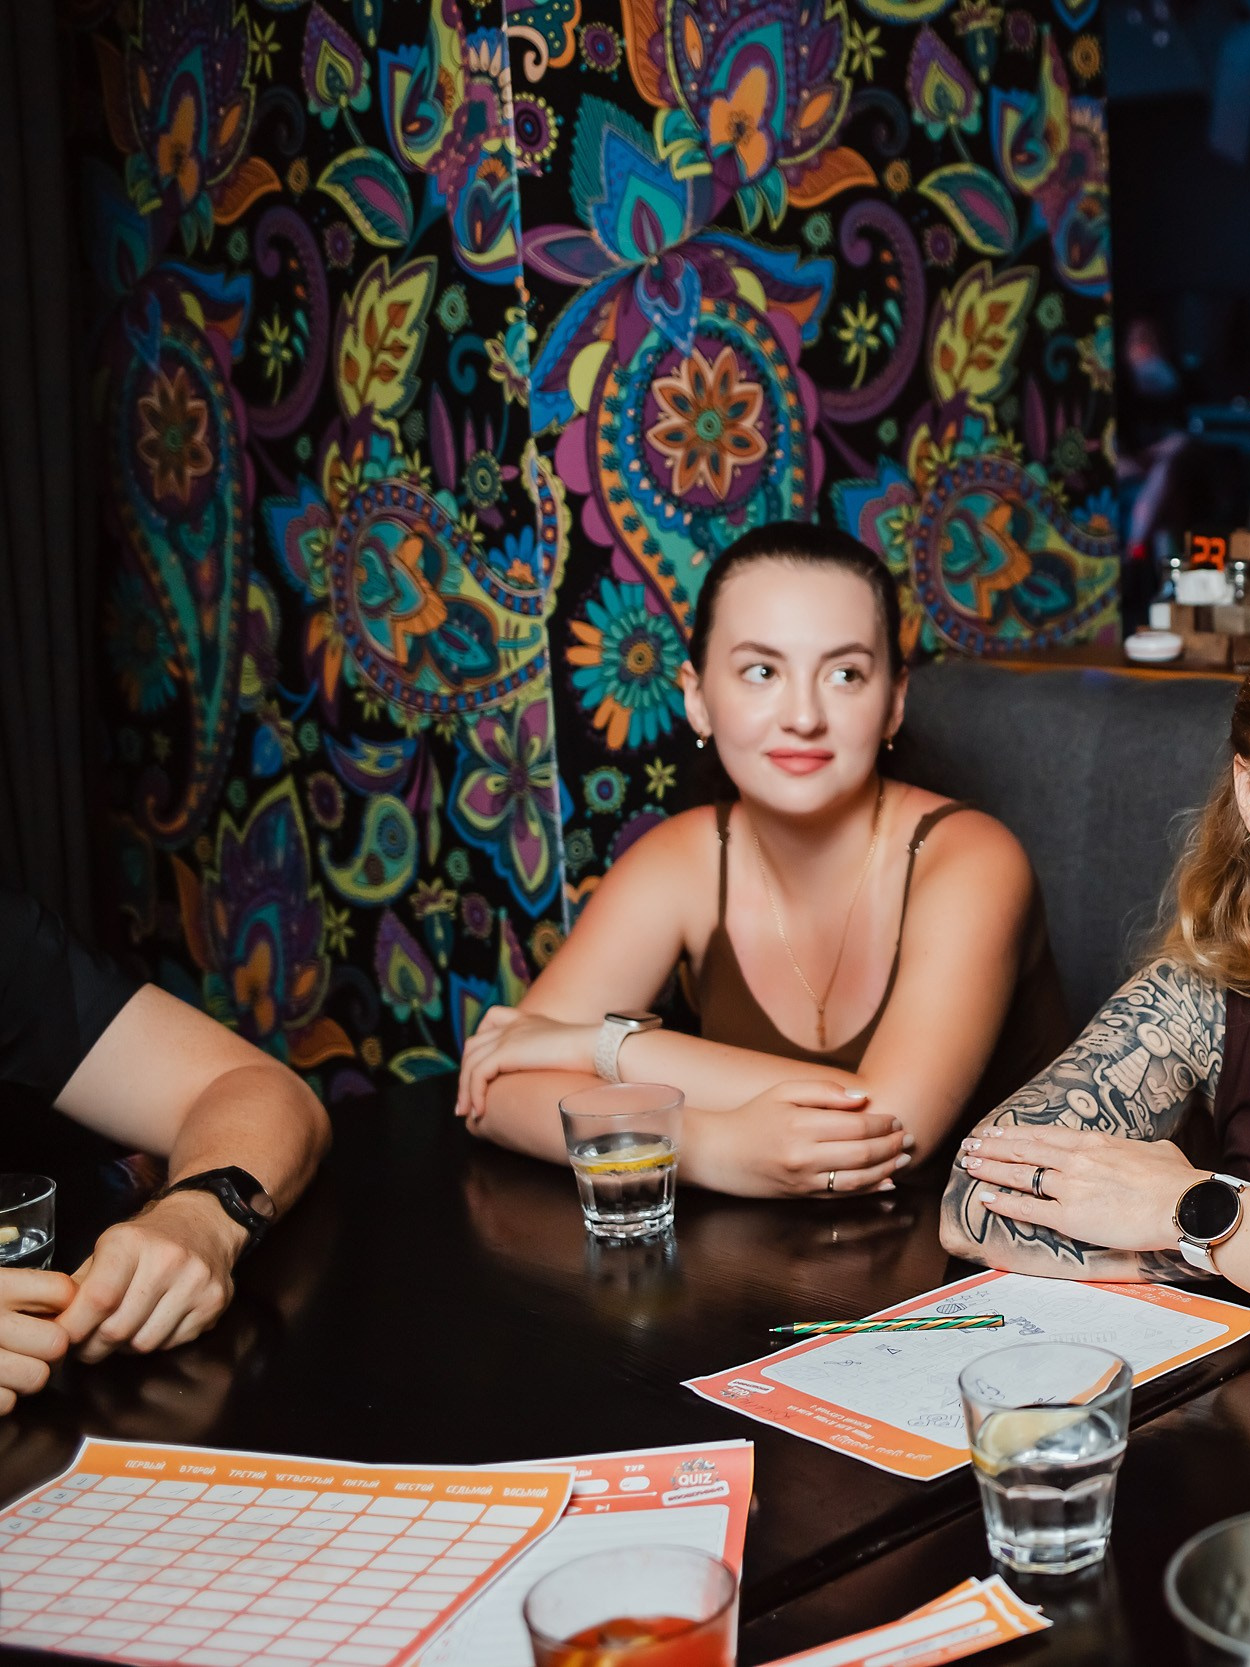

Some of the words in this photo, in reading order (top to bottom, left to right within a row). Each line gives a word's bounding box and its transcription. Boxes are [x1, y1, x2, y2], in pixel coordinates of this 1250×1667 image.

[125, 1459, 166, 1471] ПЕРВЫЙ
[179, 1465, 216, 1476] ВТОРОЙ
[228, 1469, 268, 1480] ТРЕТИЙ
[275, 1473, 334, 1486] ЧЕТВЕРТЫЙ
[343, 1478, 380, 1489] ПЯТЫЙ
[394, 1482, 435, 1493] ШЕСТОЙ
[446, 1485, 493, 1496] СЕДЬМОЙ
[503, 1487, 549, 1499] ВОСЬМОЙ
[678, 1472, 712, 1487] QUIZ
